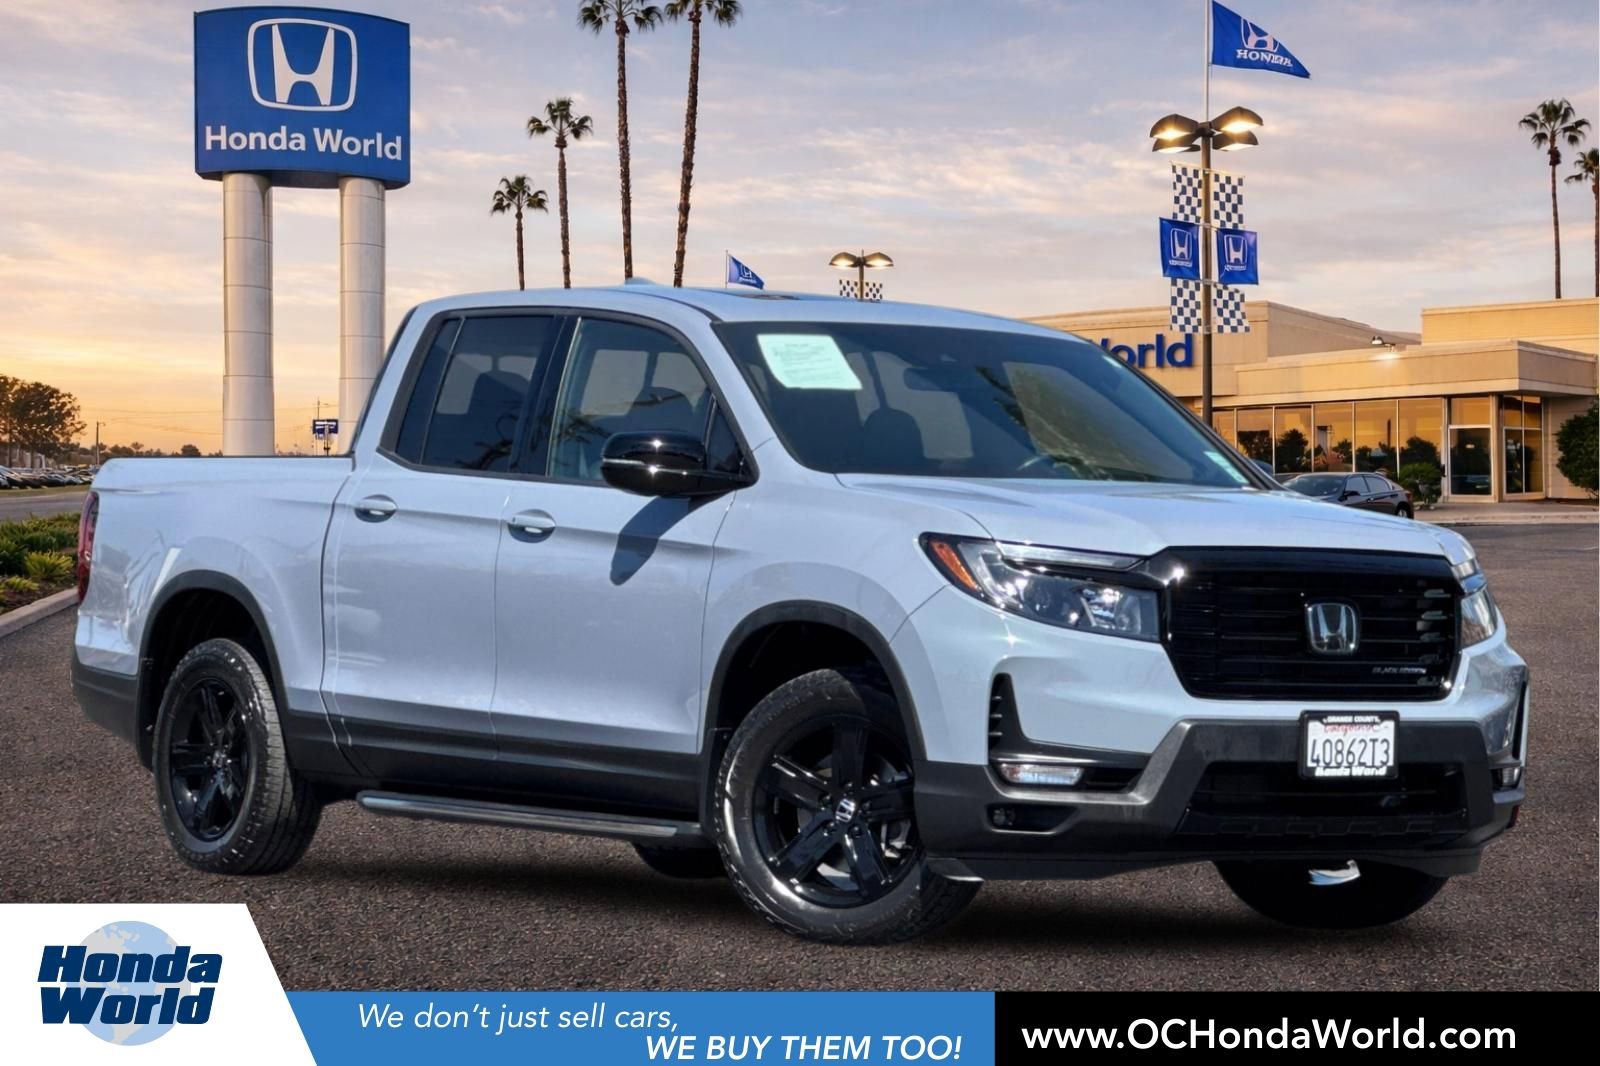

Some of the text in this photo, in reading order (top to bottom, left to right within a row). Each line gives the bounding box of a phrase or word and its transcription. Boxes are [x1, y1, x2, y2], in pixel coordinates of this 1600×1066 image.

[205, 125, 402, 160] Honda World
[1100, 333, 1194, 368] orld
[1311, 738, 1390, 767] 40862T3
